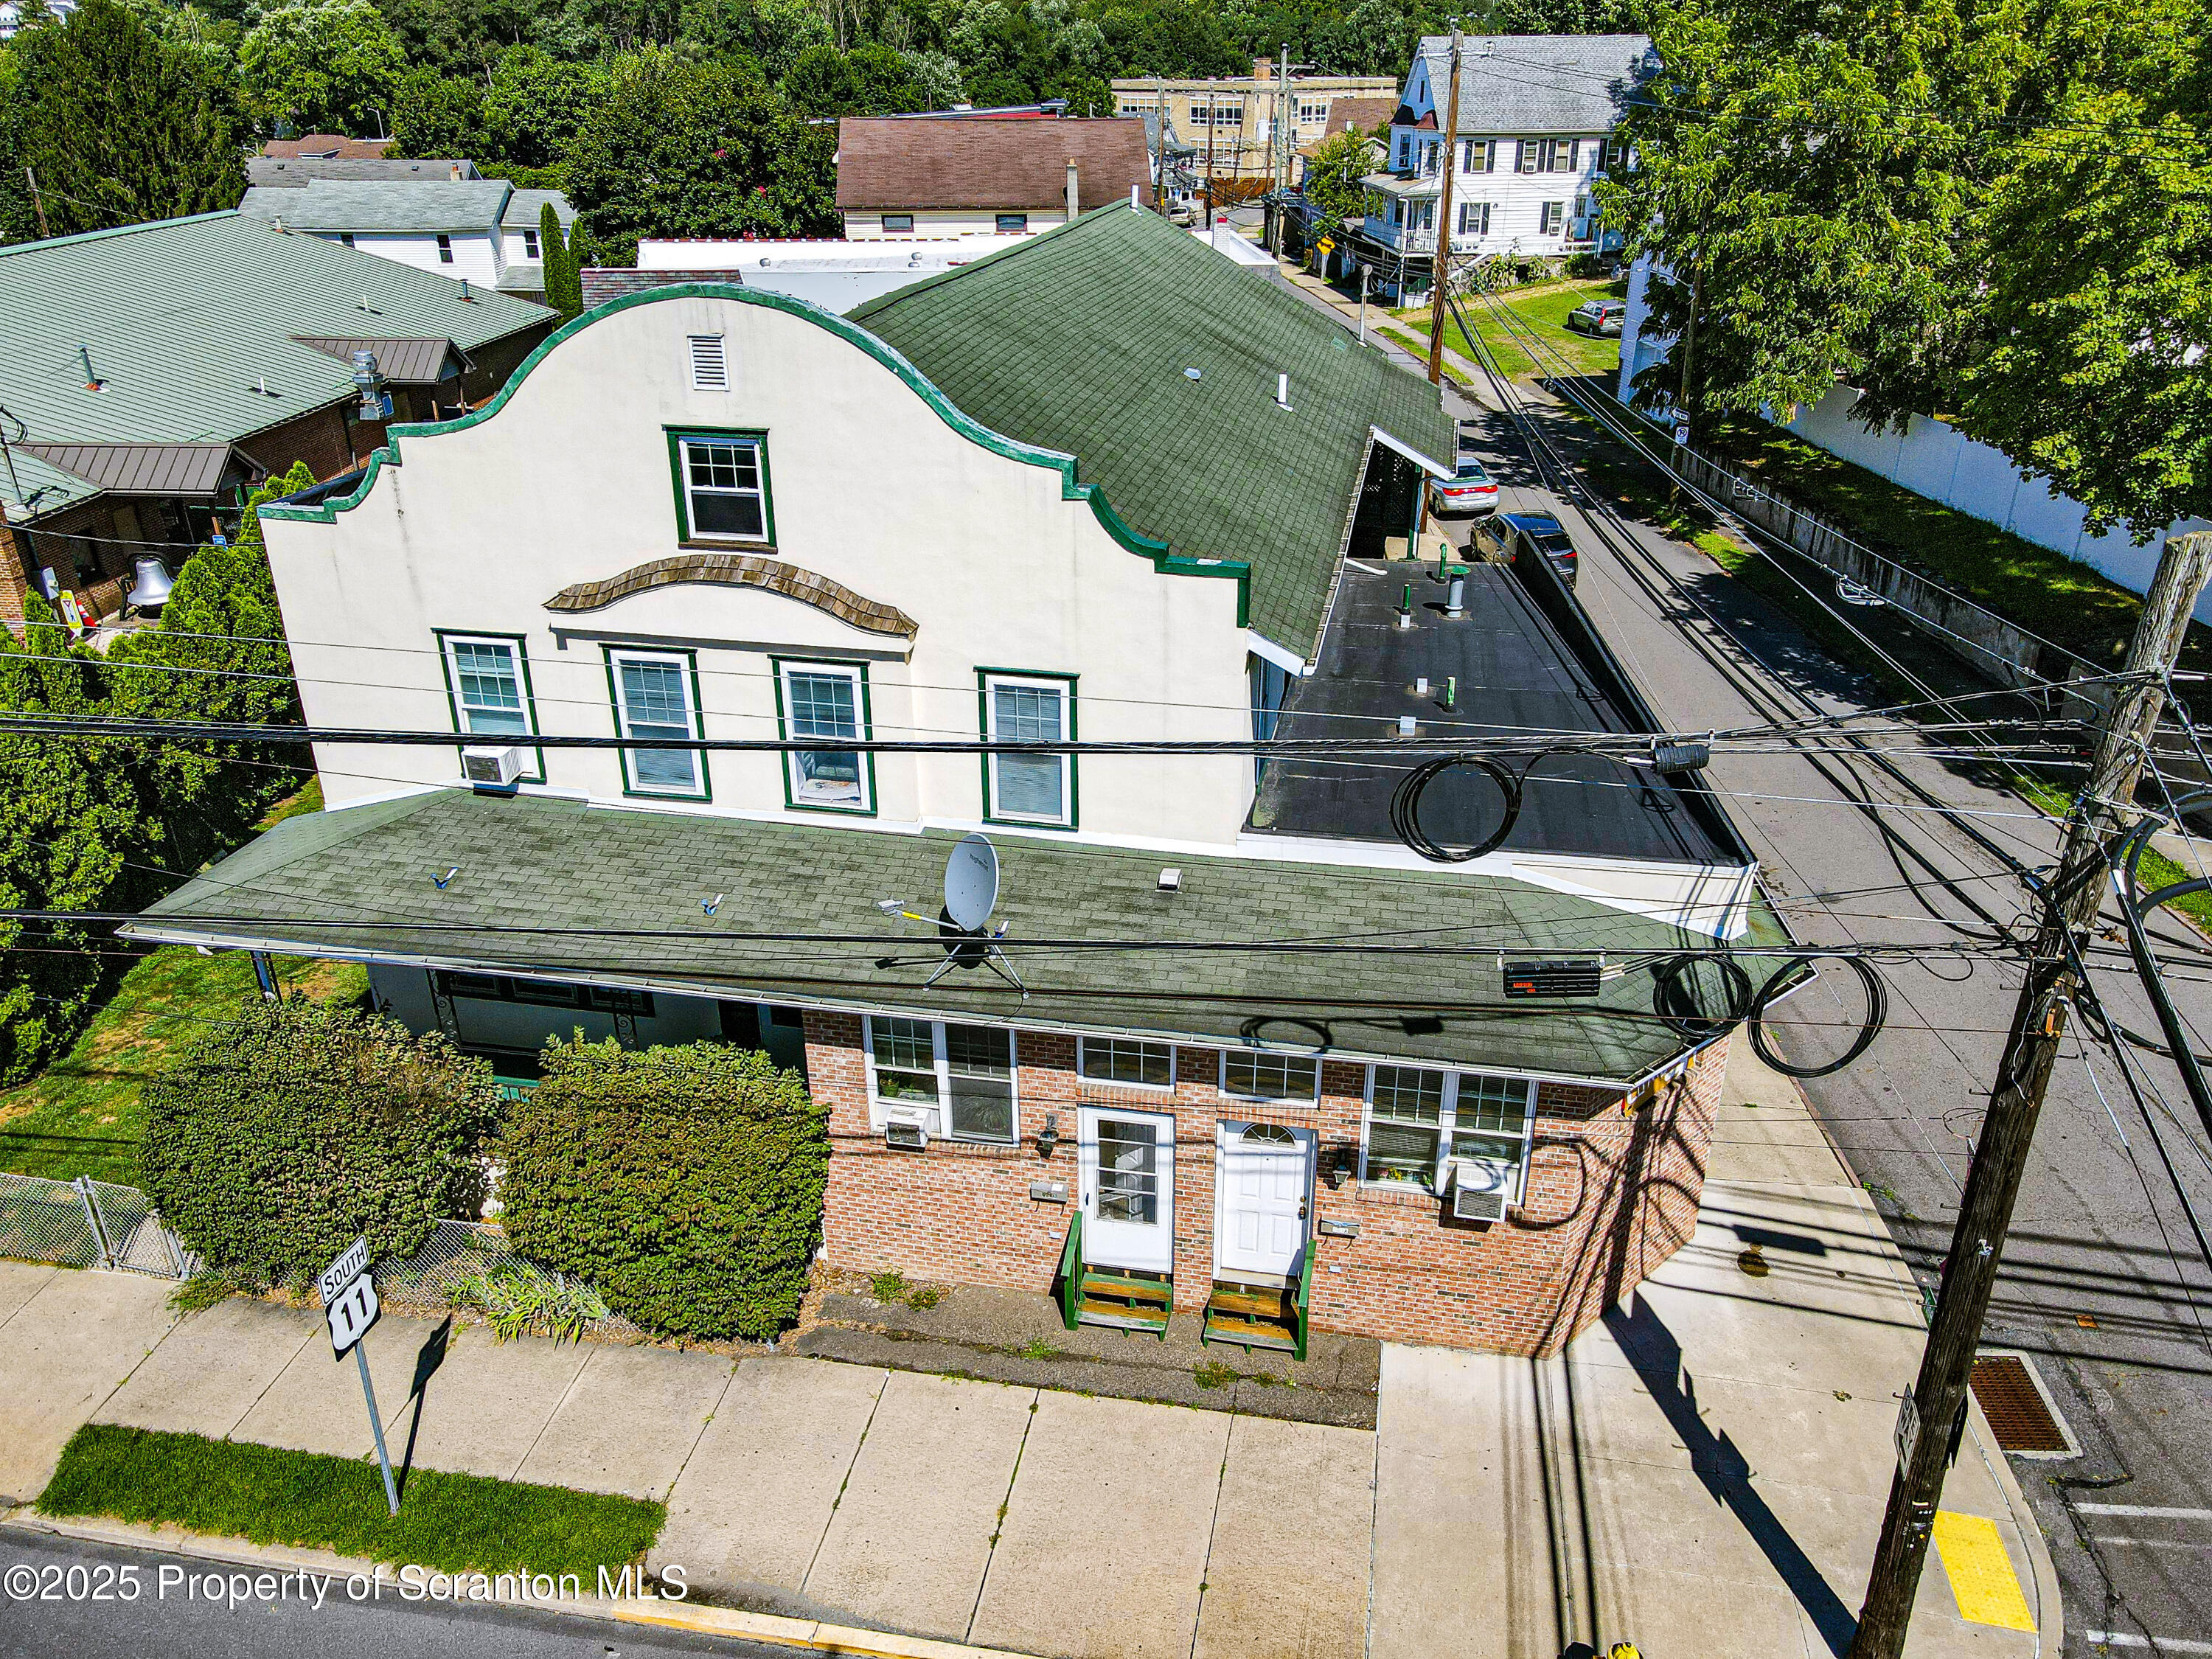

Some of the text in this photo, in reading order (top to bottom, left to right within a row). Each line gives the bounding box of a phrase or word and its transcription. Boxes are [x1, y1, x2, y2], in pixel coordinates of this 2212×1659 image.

[324, 1245, 366, 1295] SOUTH
[341, 1287, 368, 1332] 11
[1901, 1408, 1913, 1449] WAY
[1905, 1396, 1917, 1436] ONE
